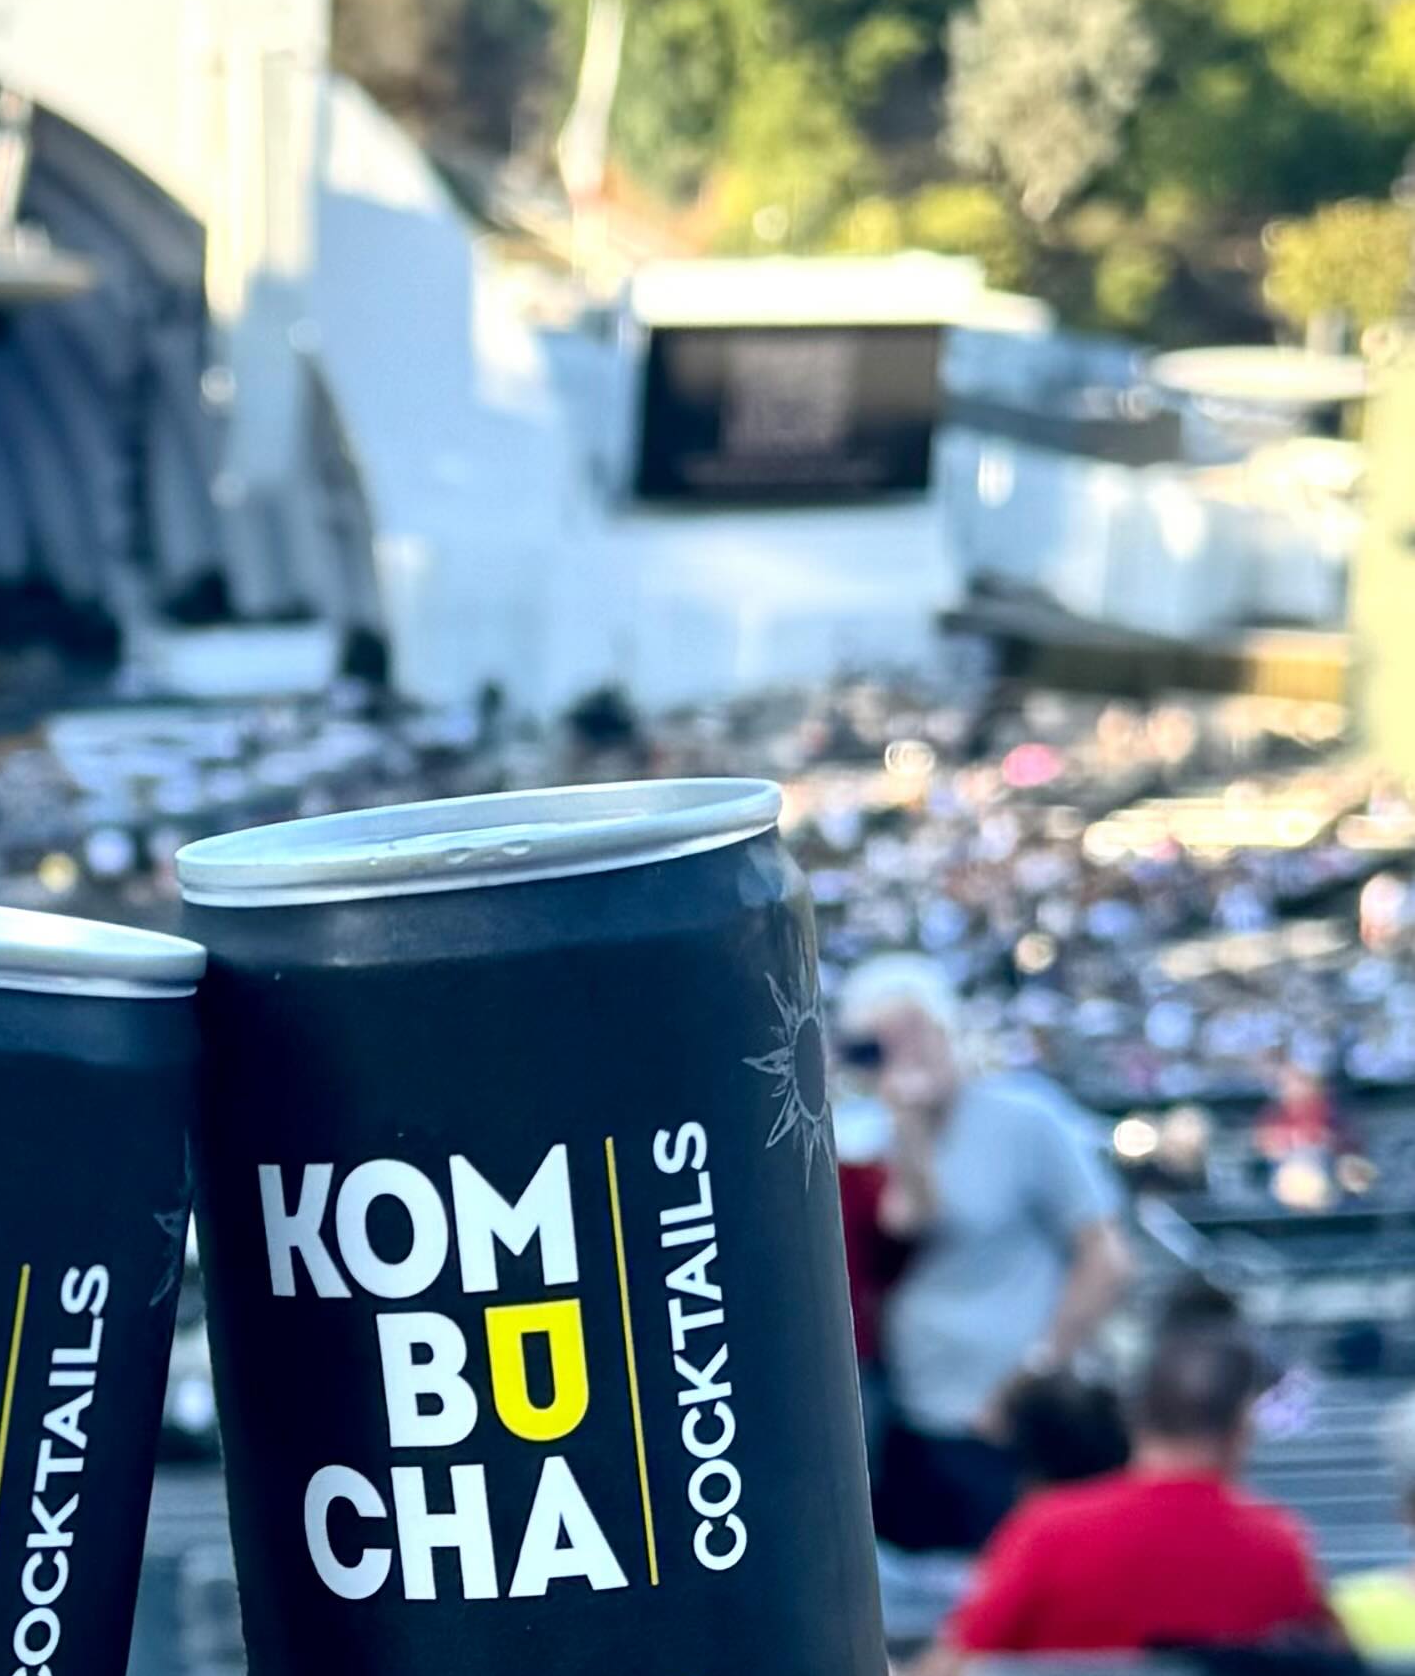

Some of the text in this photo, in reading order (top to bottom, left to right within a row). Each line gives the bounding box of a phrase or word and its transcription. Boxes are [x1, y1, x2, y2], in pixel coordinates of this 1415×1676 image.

[257, 1142, 581, 1300] KOM
[374, 1296, 591, 1449] BU
[651, 1120, 749, 1572] COCKTAILS
[303, 1454, 630, 1602] CHA
